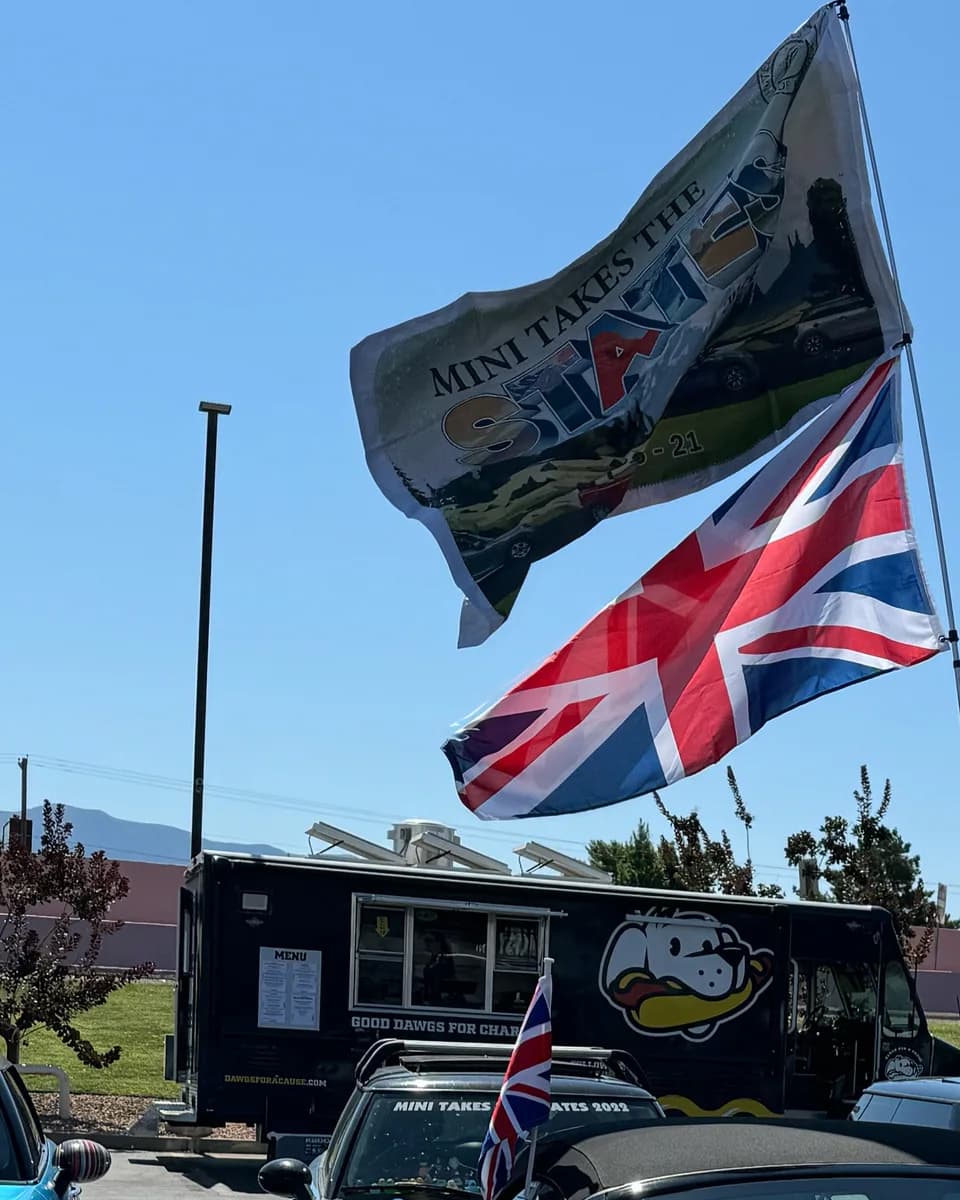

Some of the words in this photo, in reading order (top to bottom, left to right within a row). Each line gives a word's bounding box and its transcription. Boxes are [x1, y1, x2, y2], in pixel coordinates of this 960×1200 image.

[429, 337, 529, 397] MINI
[525, 249, 635, 347] TAKES
[632, 180, 705, 252] THE
[668, 430, 704, 458] 21
[274, 950, 308, 962] MENU
[351, 1016, 391, 1030] GOOD
[393, 1018, 445, 1033] DAWGS
[448, 1022, 477, 1035] FOR
[393, 1102, 434, 1112] MINI
[438, 1102, 491, 1112] TAKES
[591, 1102, 630, 1112] 2022
